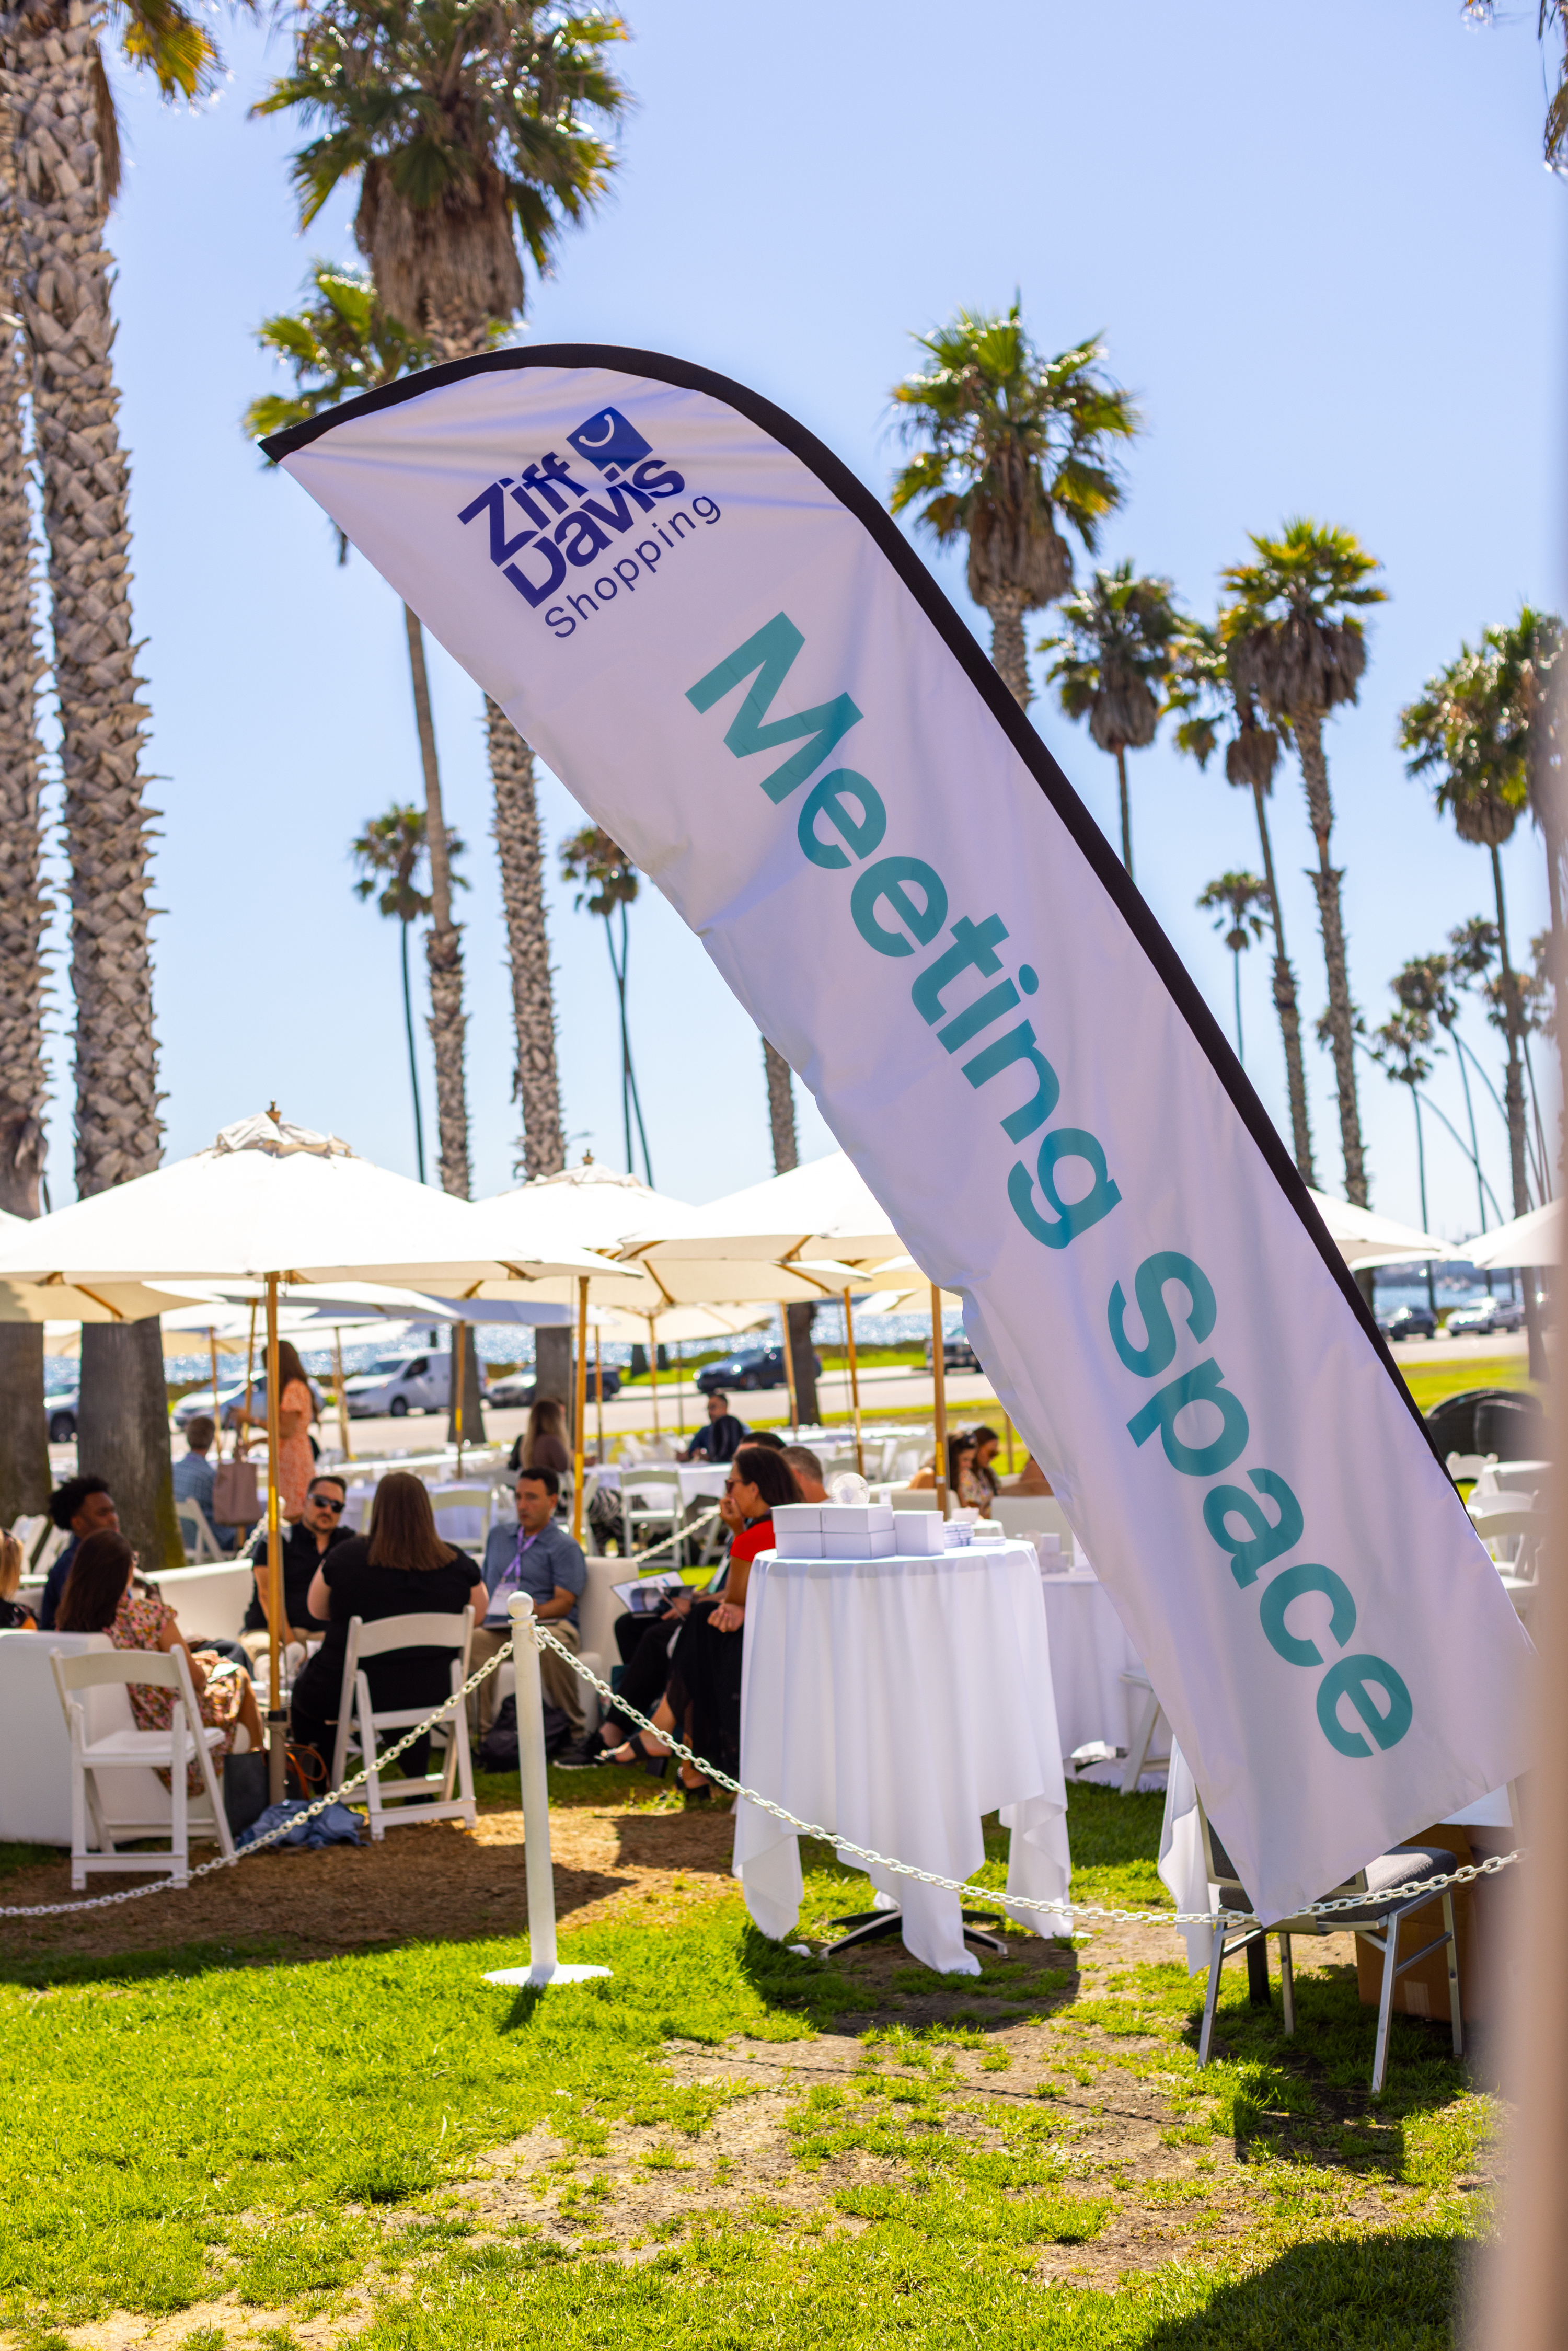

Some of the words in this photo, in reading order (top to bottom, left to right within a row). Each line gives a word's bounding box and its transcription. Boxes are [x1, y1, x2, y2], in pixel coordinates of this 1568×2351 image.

[457, 451, 589, 567] Ziff
[502, 460, 685, 608] Davis
[545, 496, 721, 638] Shopping
[684, 611, 1123, 1249] Meeting
[1108, 1251, 1413, 1758] Space
